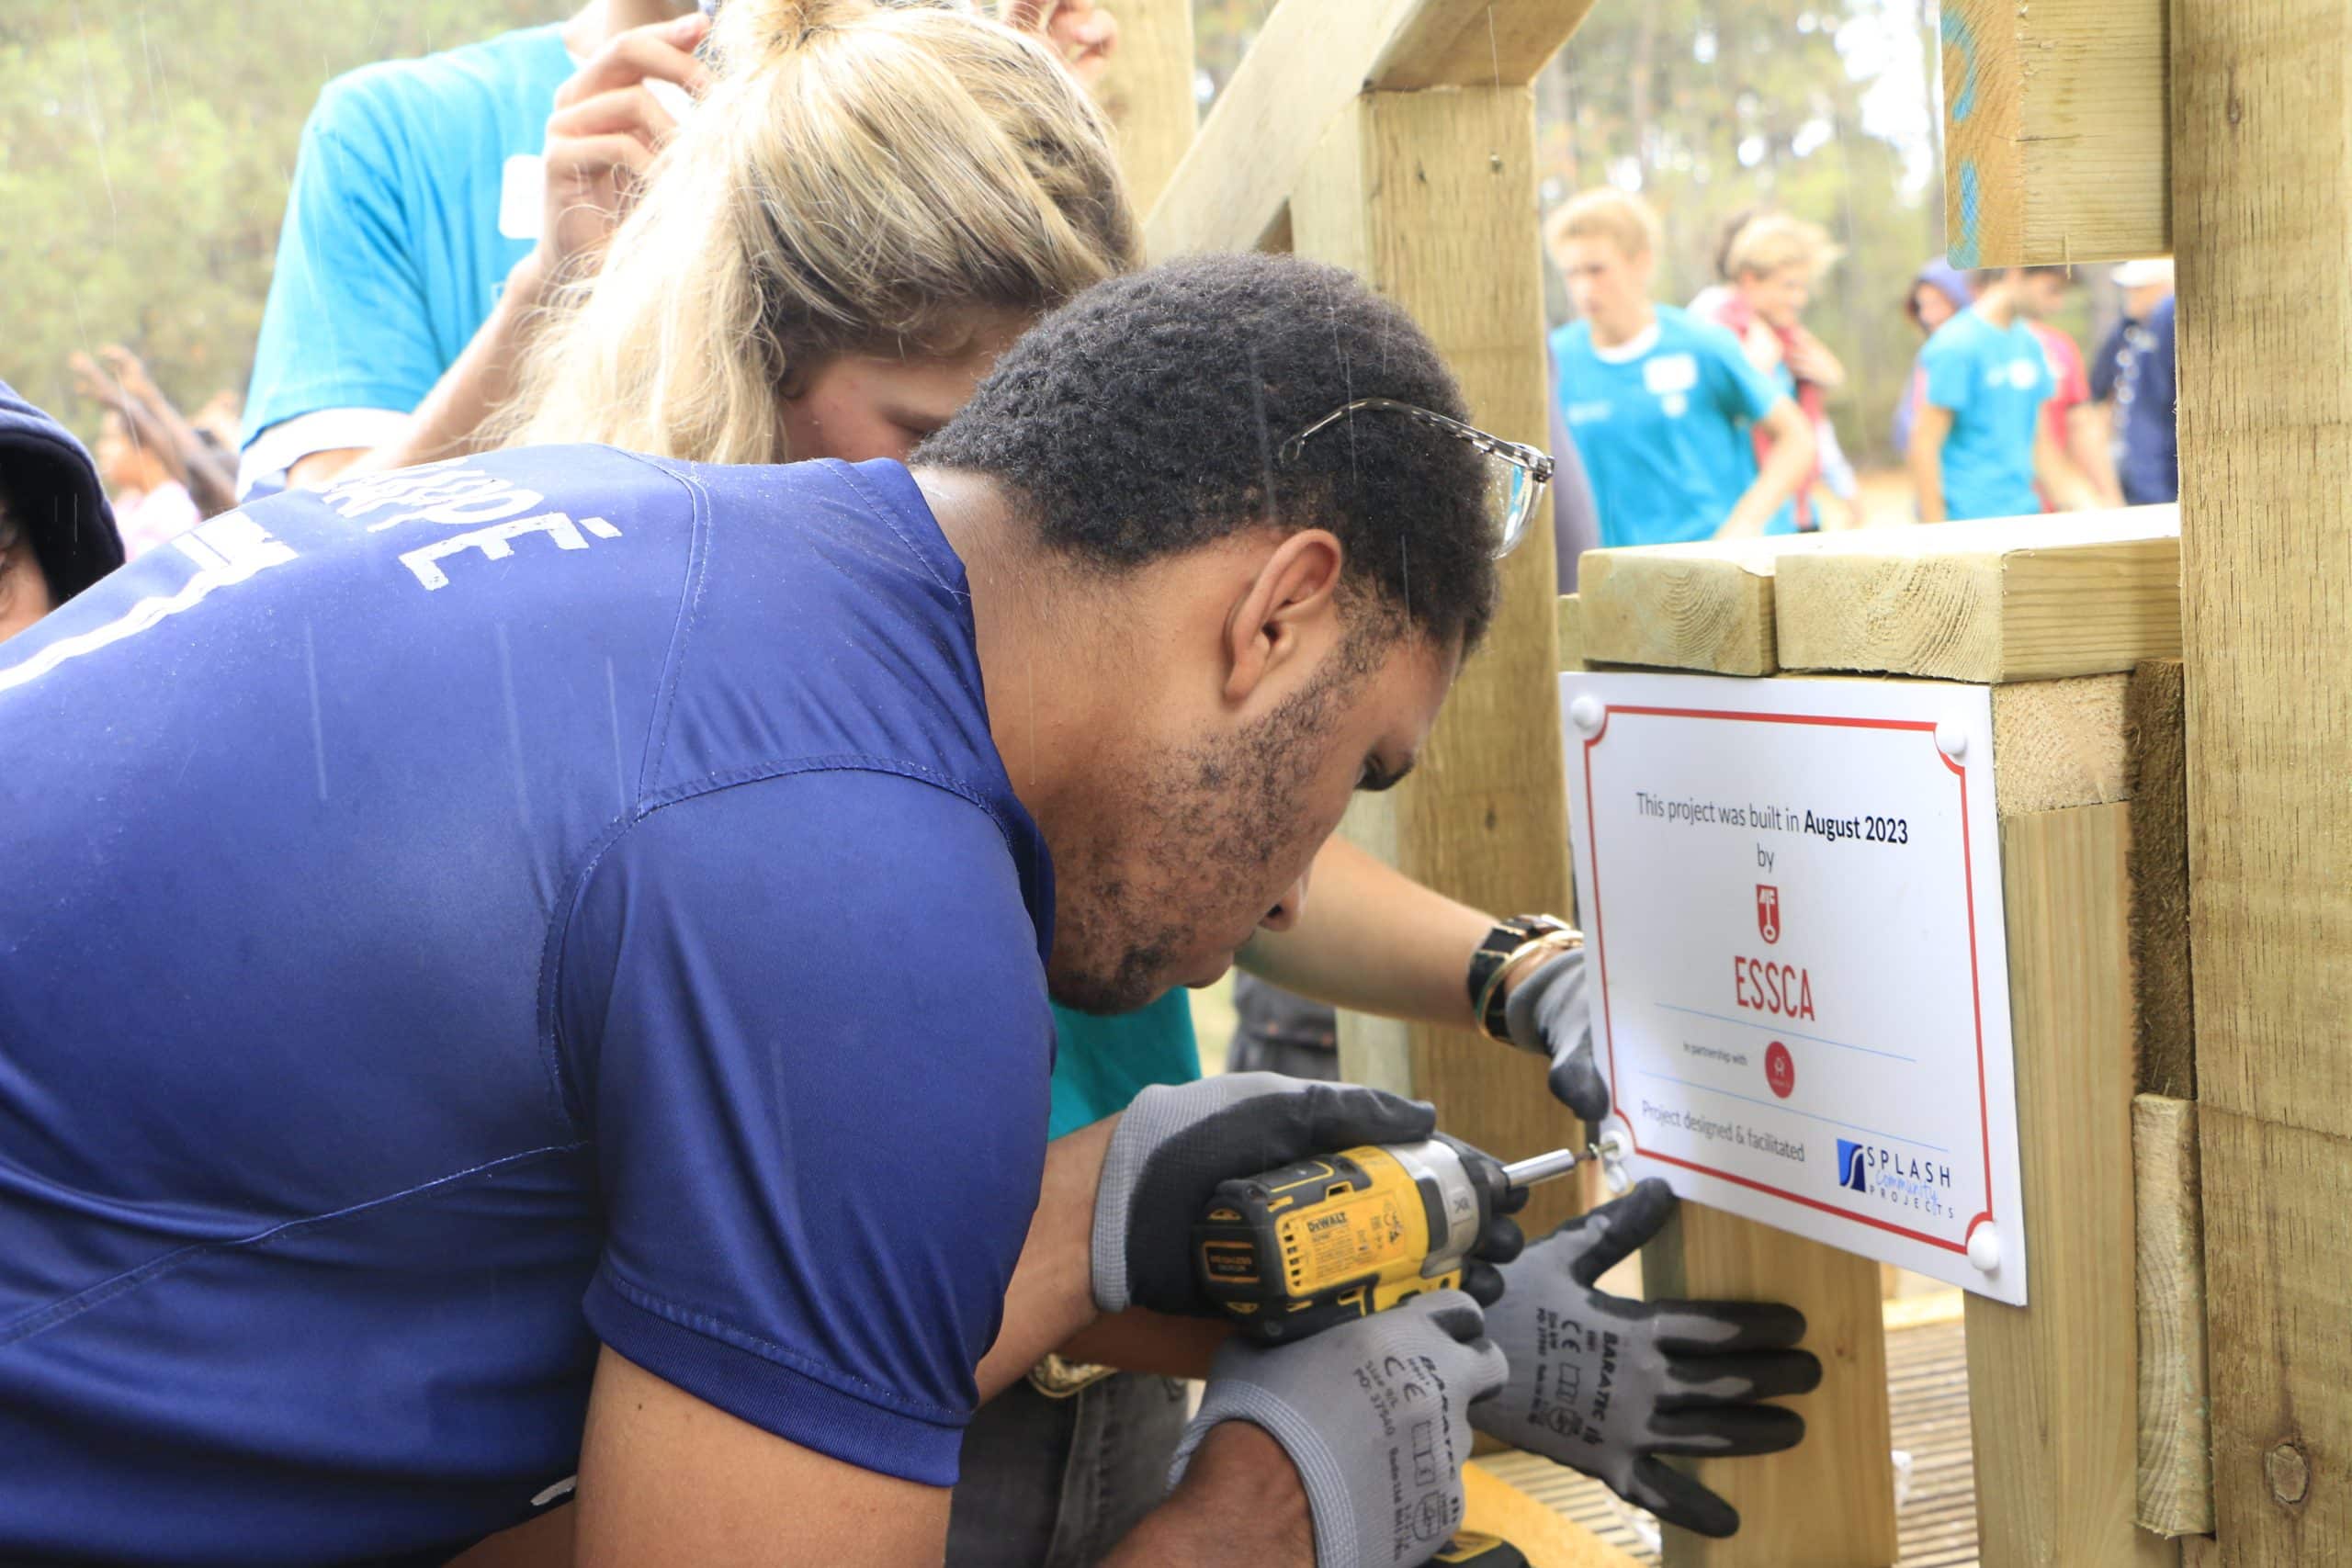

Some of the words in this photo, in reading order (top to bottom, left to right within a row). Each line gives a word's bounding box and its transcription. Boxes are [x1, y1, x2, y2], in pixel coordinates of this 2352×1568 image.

[1635, 792, 1665, 818] This
[1668, 797, 1715, 825] project
[1718, 807, 1746, 827] was
[1749, 803, 1782, 830] built
[1785, 807, 1800, 832] in
[1804, 809, 1861, 842] August
[1865, 816, 1908, 844] 2023
[1756, 841, 1775, 873] by
[1734, 955, 1815, 1021] ESSCA
[1641, 1100, 1681, 1128] Project
[1684, 1110, 1733, 1141] designed
[1735, 1125, 1745, 1145] &
[1747, 1128, 1805, 1163] facilitated
[1866, 1145, 1951, 1189] SPLASH
[1869, 1185, 1954, 1220] PROJECTS
[1875, 1168, 1939, 1216] Community
